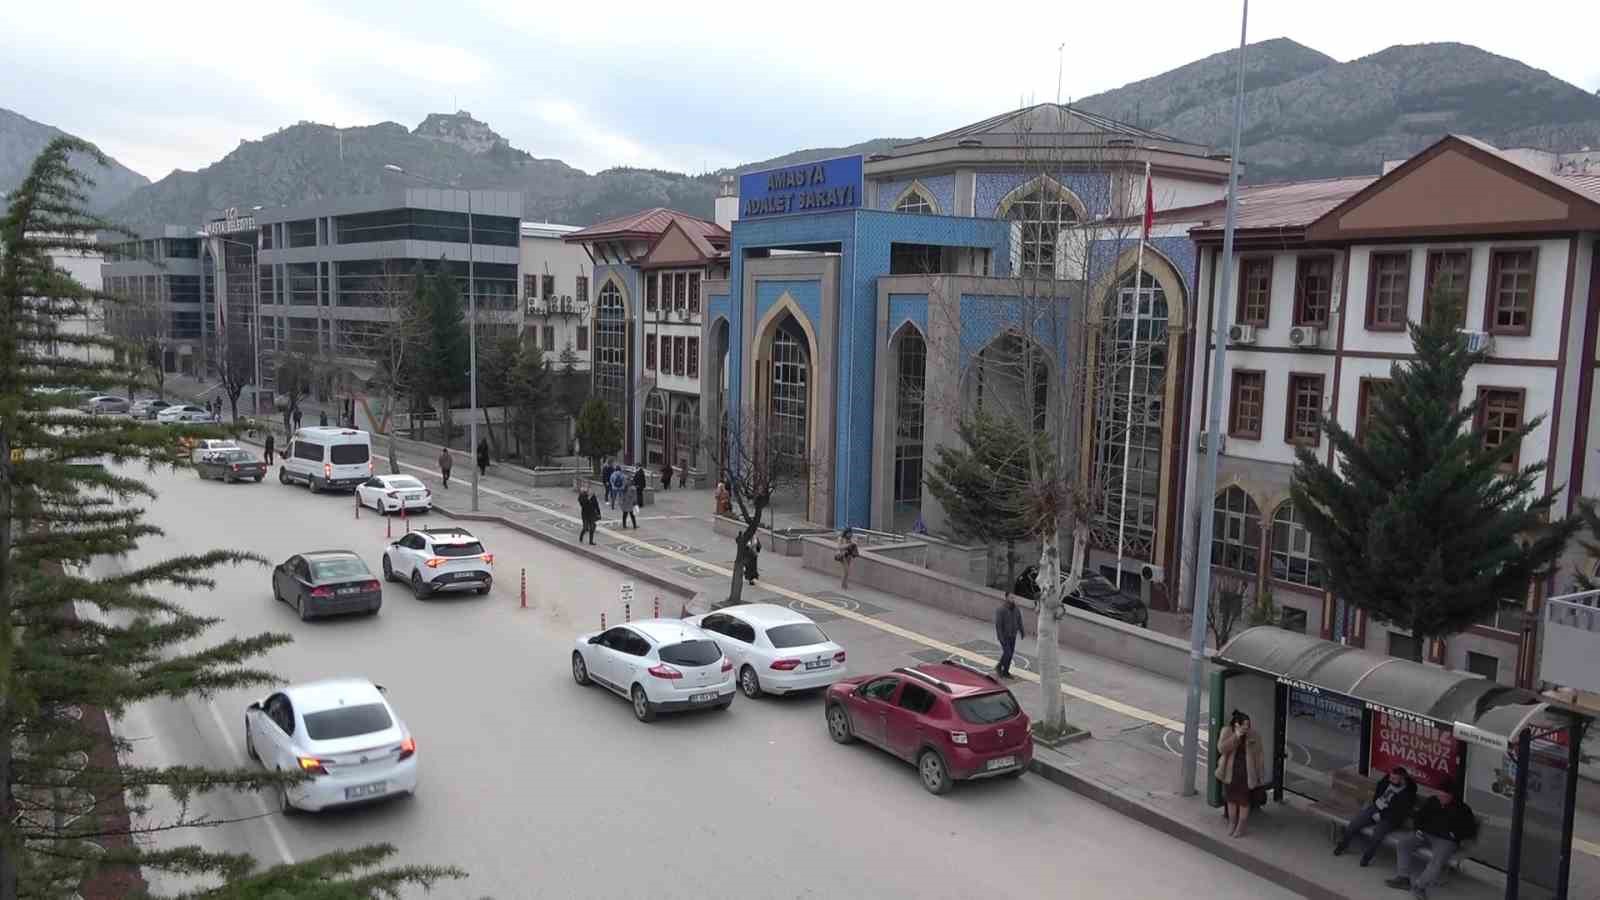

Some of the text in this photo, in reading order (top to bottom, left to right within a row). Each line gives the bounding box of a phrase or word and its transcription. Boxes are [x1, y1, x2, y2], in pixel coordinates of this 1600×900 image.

[767, 165, 825, 191] AMASYA
[744, 184, 855, 216] ADALET SARAYI
[1276, 677, 1320, 695] AMASYA
[1379, 741, 1449, 773] AMASYA
